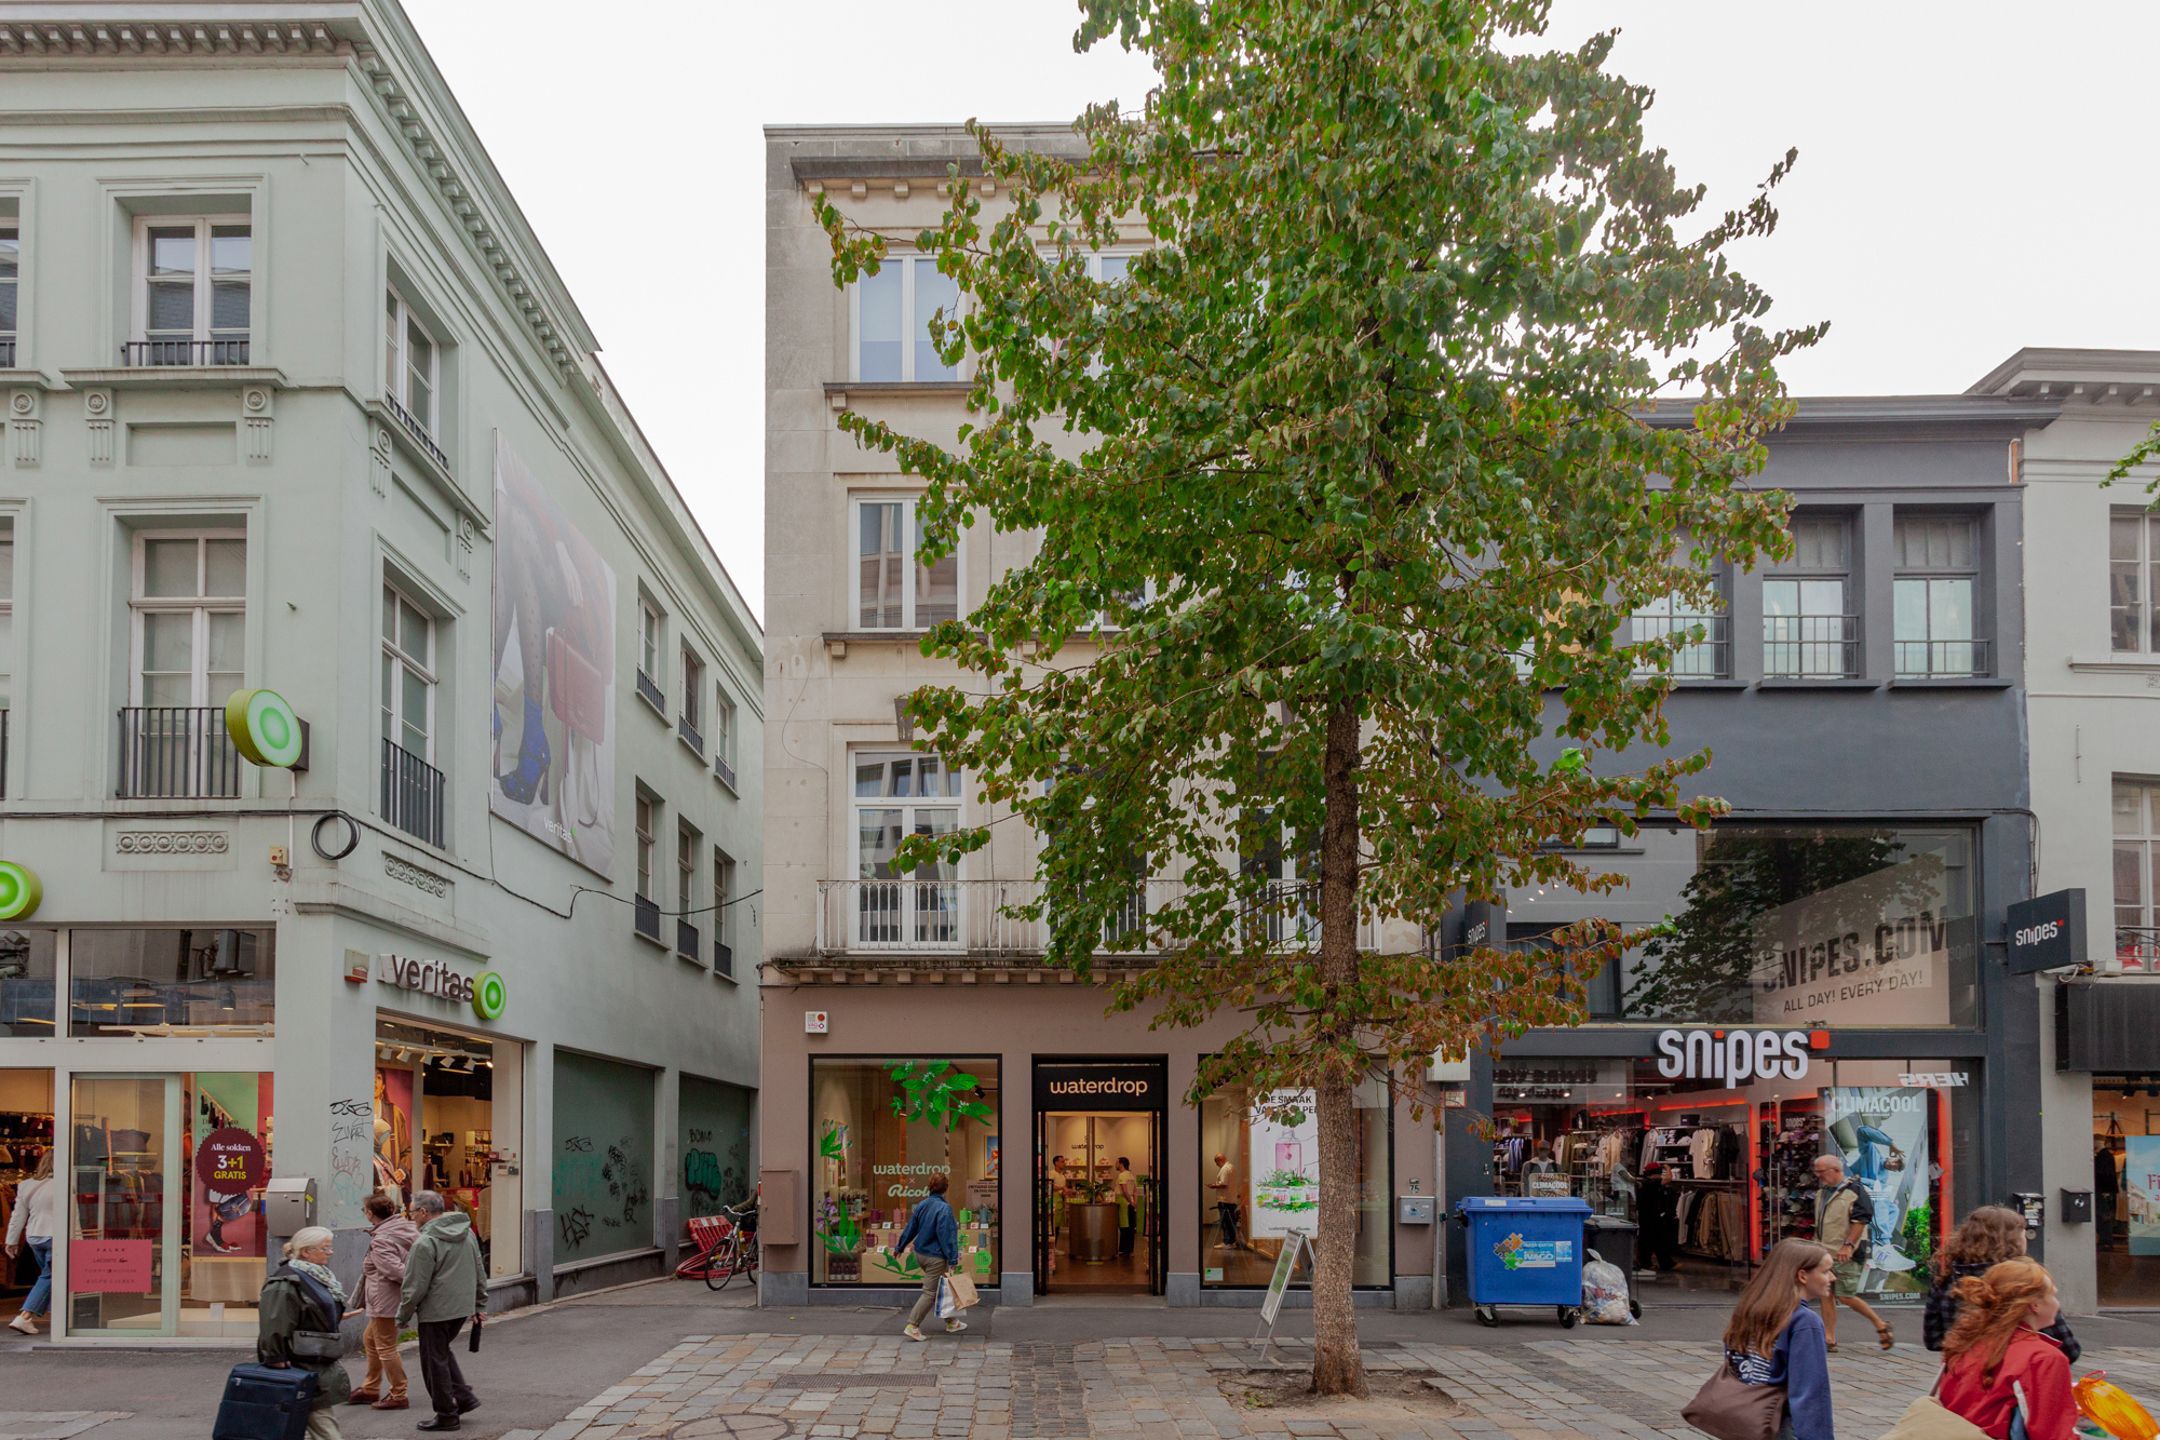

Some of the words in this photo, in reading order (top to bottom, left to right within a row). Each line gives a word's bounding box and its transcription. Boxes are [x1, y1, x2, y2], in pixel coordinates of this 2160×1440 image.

[543, 816, 573, 843] veritas
[2015, 921, 2058, 946] snipes
[392, 954, 475, 1003] veritas
[1783, 996, 1804, 1013] ALL
[1807, 990, 1836, 1007] DAY!
[1840, 979, 1883, 1001] EVERY
[1889, 970, 1923, 990] DAY!
[1656, 1029, 1809, 1090] snipes
[1050, 1077, 1148, 1097] waterdrop
[1831, 1095, 1921, 1113] CLIMACOOL
[211, 1143, 226, 1151] Alle
[226, 1143, 252, 1152] sokken
[217, 1154, 244, 1169] 3+1
[872, 1162, 951, 1175] waterdrop
[213, 1171, 247, 1180] GRATIS
[887, 1183, 931, 1198] Ricol
